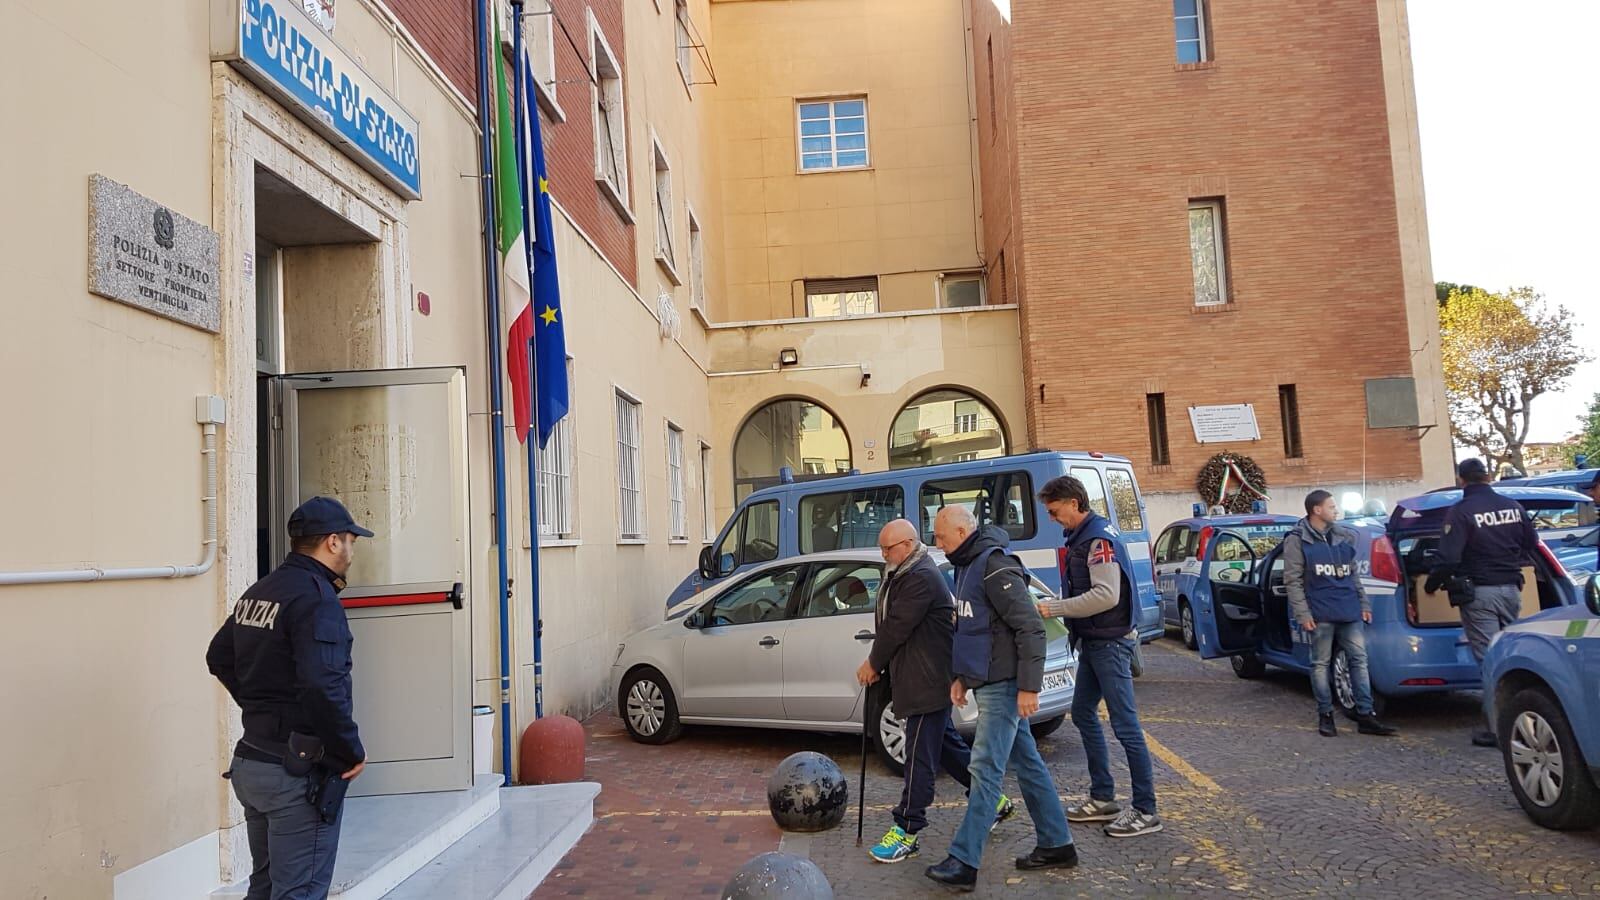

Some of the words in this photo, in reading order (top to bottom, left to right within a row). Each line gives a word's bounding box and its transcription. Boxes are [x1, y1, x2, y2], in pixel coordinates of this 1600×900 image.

[243, 0, 337, 110] POLIZIA
[341, 72, 361, 130] DI
[365, 97, 416, 175] STATO
[113, 235, 160, 265] POLIZIA
[163, 258, 172, 272] DI
[177, 262, 210, 284] STATO
[116, 260, 156, 283] SETTORE
[164, 278, 208, 303] FRONTIERA
[138, 285, 189, 312] VENTIMIGLIA
[867, 450, 875, 461] 2
[1473, 508, 1522, 528] POLIZIA
